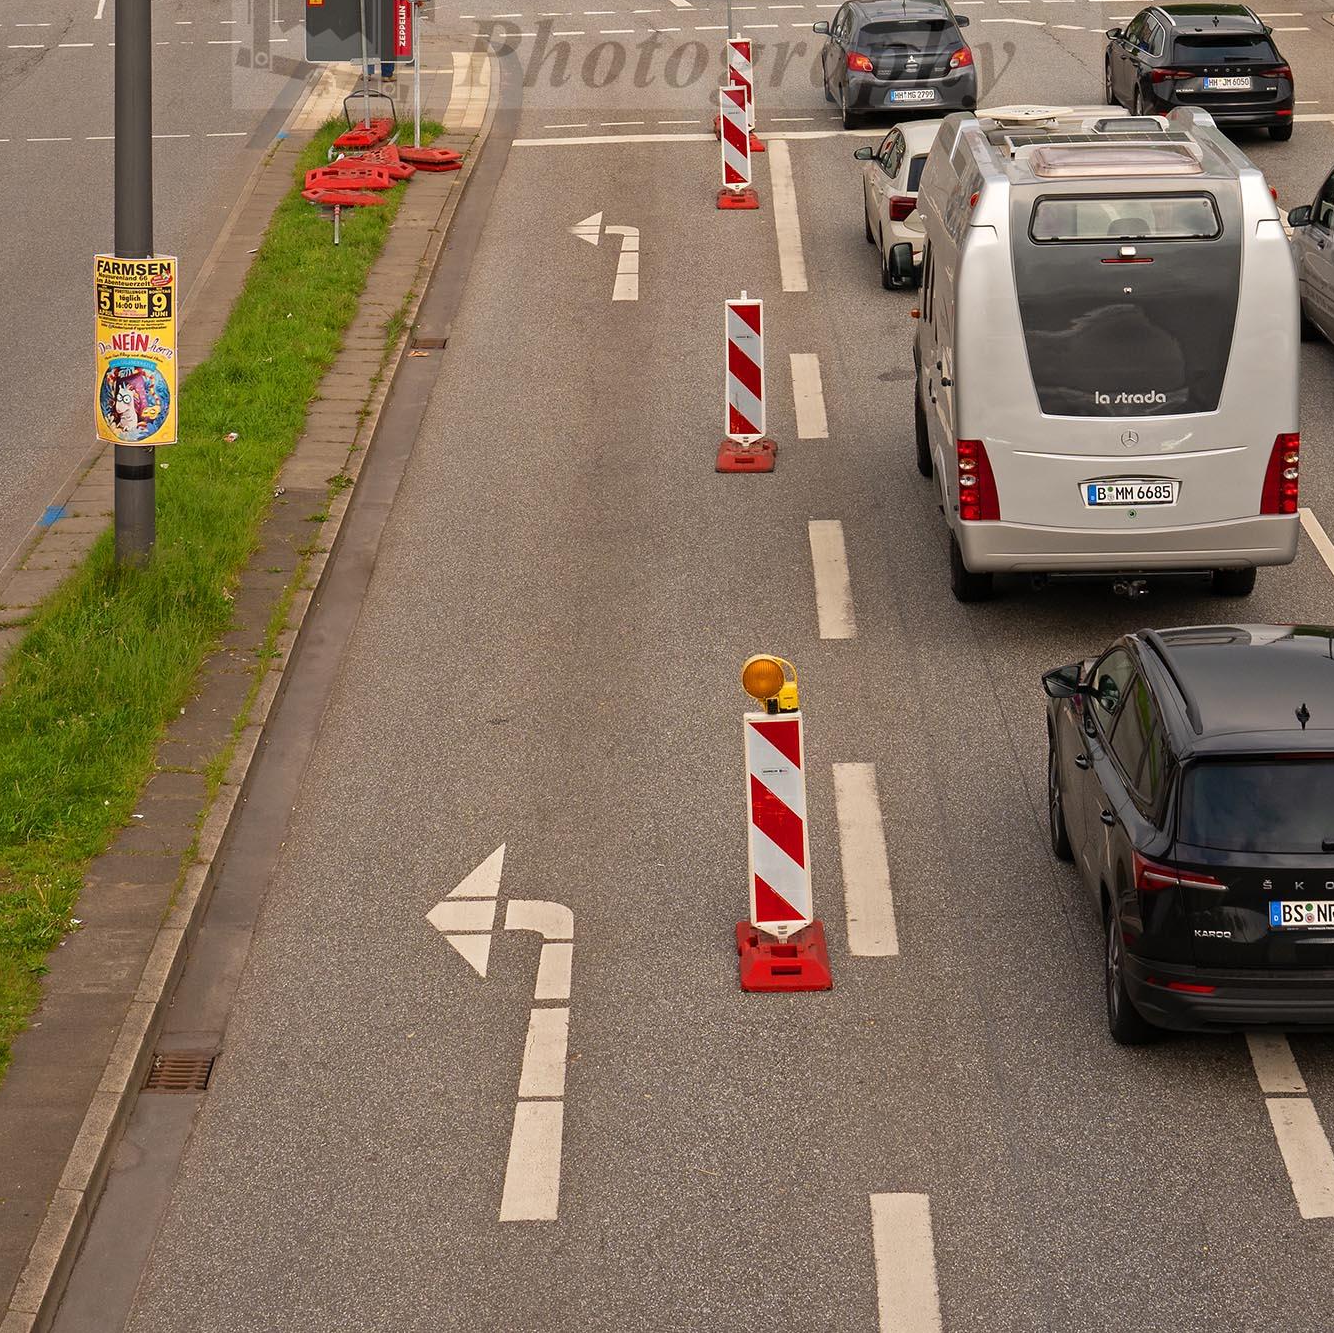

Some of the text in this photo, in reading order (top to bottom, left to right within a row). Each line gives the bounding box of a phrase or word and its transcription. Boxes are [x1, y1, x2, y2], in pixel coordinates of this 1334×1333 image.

[398, 5, 406, 47] ZEPPELIN
[1208, 78, 1218, 86] HH
[1233, 78, 1250, 86] 6050
[894, 91, 934, 99] HH MG 2799
[97, 259, 171, 276] FARMSEN
[99, 291, 111, 310] 5
[119, 294, 141, 302] täglich
[152, 293, 167, 312] 9
[1095, 389, 1167, 404] la strada
[1097, 485, 1171, 501] B MM 6685
[1282, 903, 1304, 923] BS
